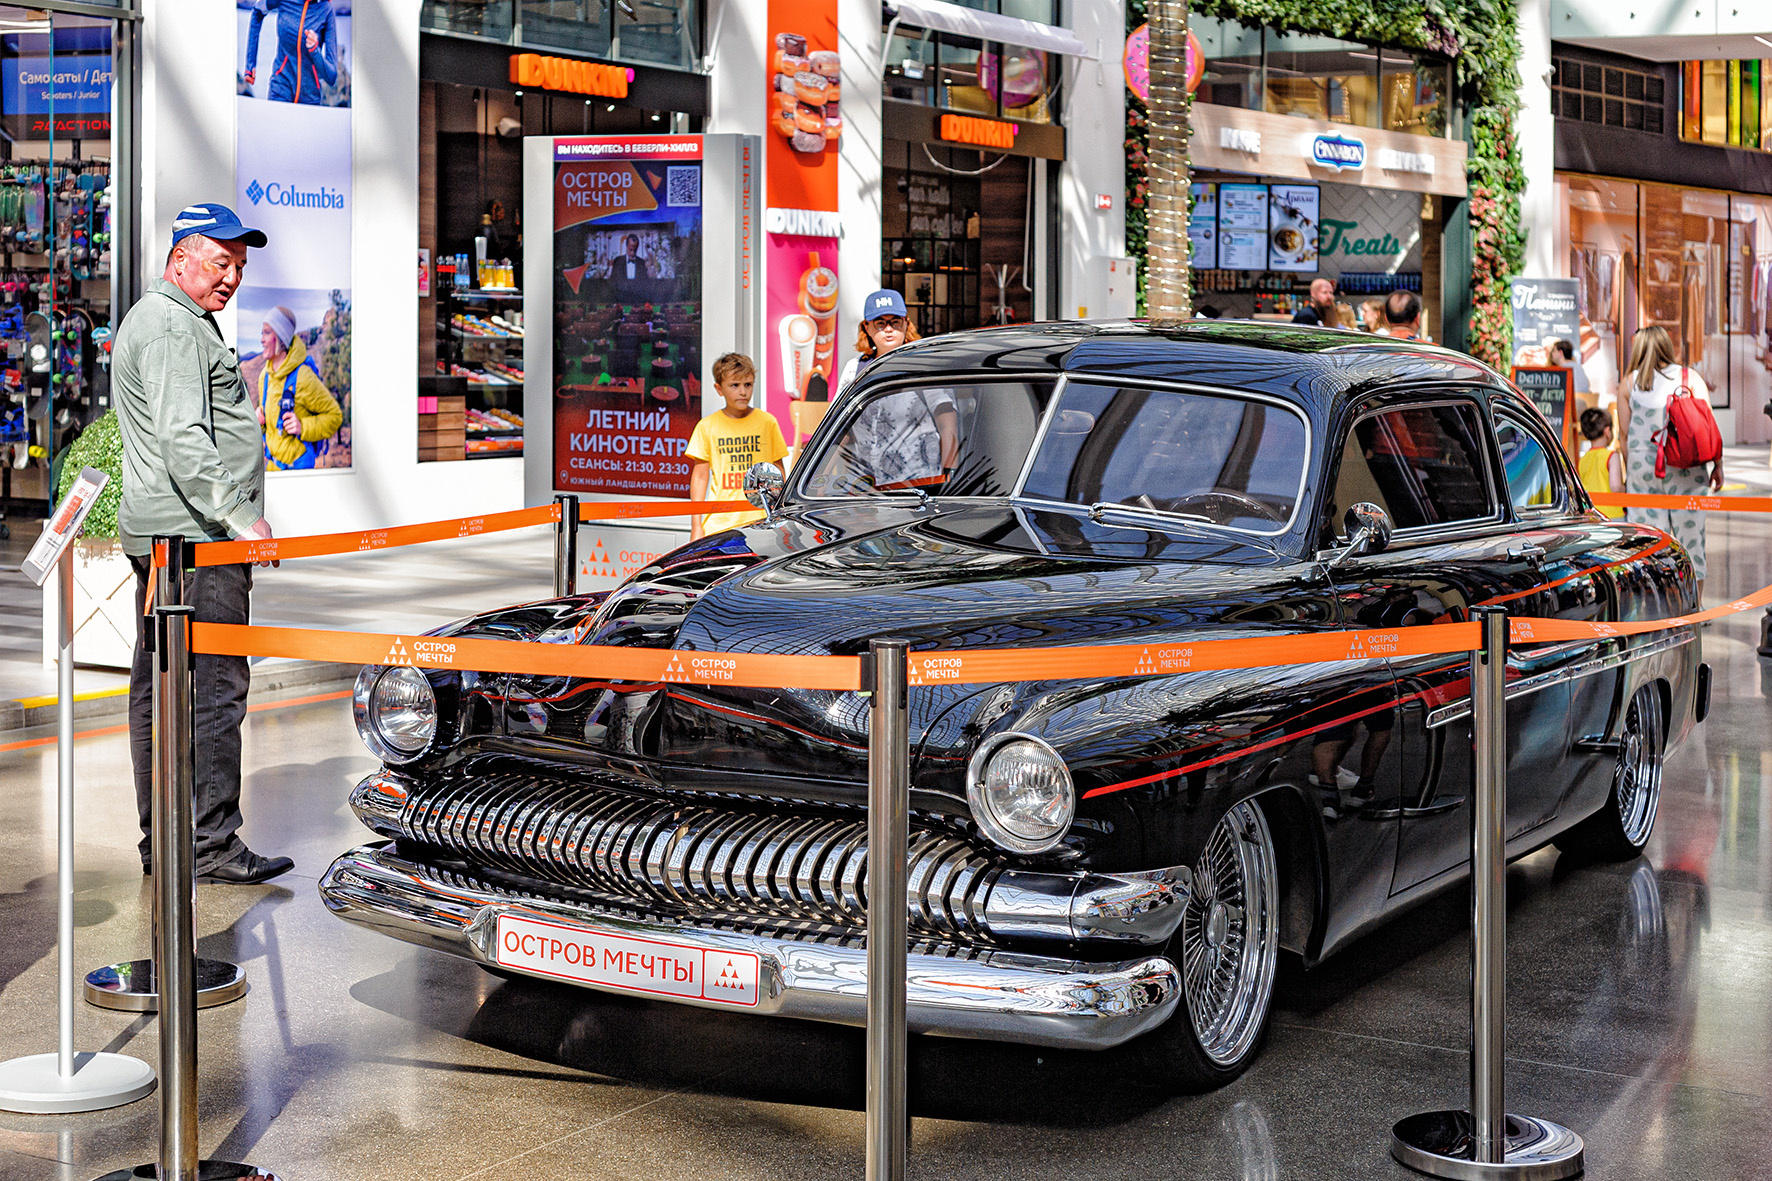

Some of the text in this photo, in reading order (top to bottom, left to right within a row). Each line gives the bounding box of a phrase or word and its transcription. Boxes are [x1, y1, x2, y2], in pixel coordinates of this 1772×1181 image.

[90, 69, 112, 86] Дет
[557, 142, 698, 155] ВЫ НАХОДИТЕСЬ В БЕВЕРЛИ-ХИЛЛЗ
[562, 172, 633, 189] ОСТРОВ
[265, 182, 344, 209] Columbia
[567, 191, 627, 207] МЕЧТЫ
[1320, 218, 1402, 257] Treats
[586, 407, 670, 432] ЛЕТНИЙ
[570, 432, 688, 457] КИНОТЕАТР
[718, 435, 761, 454] ROOKIE
[570, 457, 690, 476] СЕАНСЫ: 21:30, 23:30
[730, 453, 753, 471] PRO
[570, 477, 690, 491] ЮЖНЫЙ ЛАНДШАФТНЫЙ ПАР
[722, 472, 746, 490] LEG
[619, 550, 662, 564] ОСТР
[1367, 634, 1399, 644] ОСТРОВ
[413, 641, 456, 653] ОСТРОВ
[1158, 648, 1193, 659] ОСТРОВ
[1370, 644, 1397, 653] МЕЧТЫ
[416, 652, 453, 664] МЕЧТЫ
[691, 658, 737, 670] ОСТРОВ
[923, 658, 962, 669] ОСТРОВ
[1160, 659, 1190, 668] МЕЧТЫ
[694, 669, 733, 680] МЕЧТЫ
[926, 669, 960, 679] МЕЧТЫ
[504, 930, 694, 984] ОСТРОВ МЕЧТЫ
